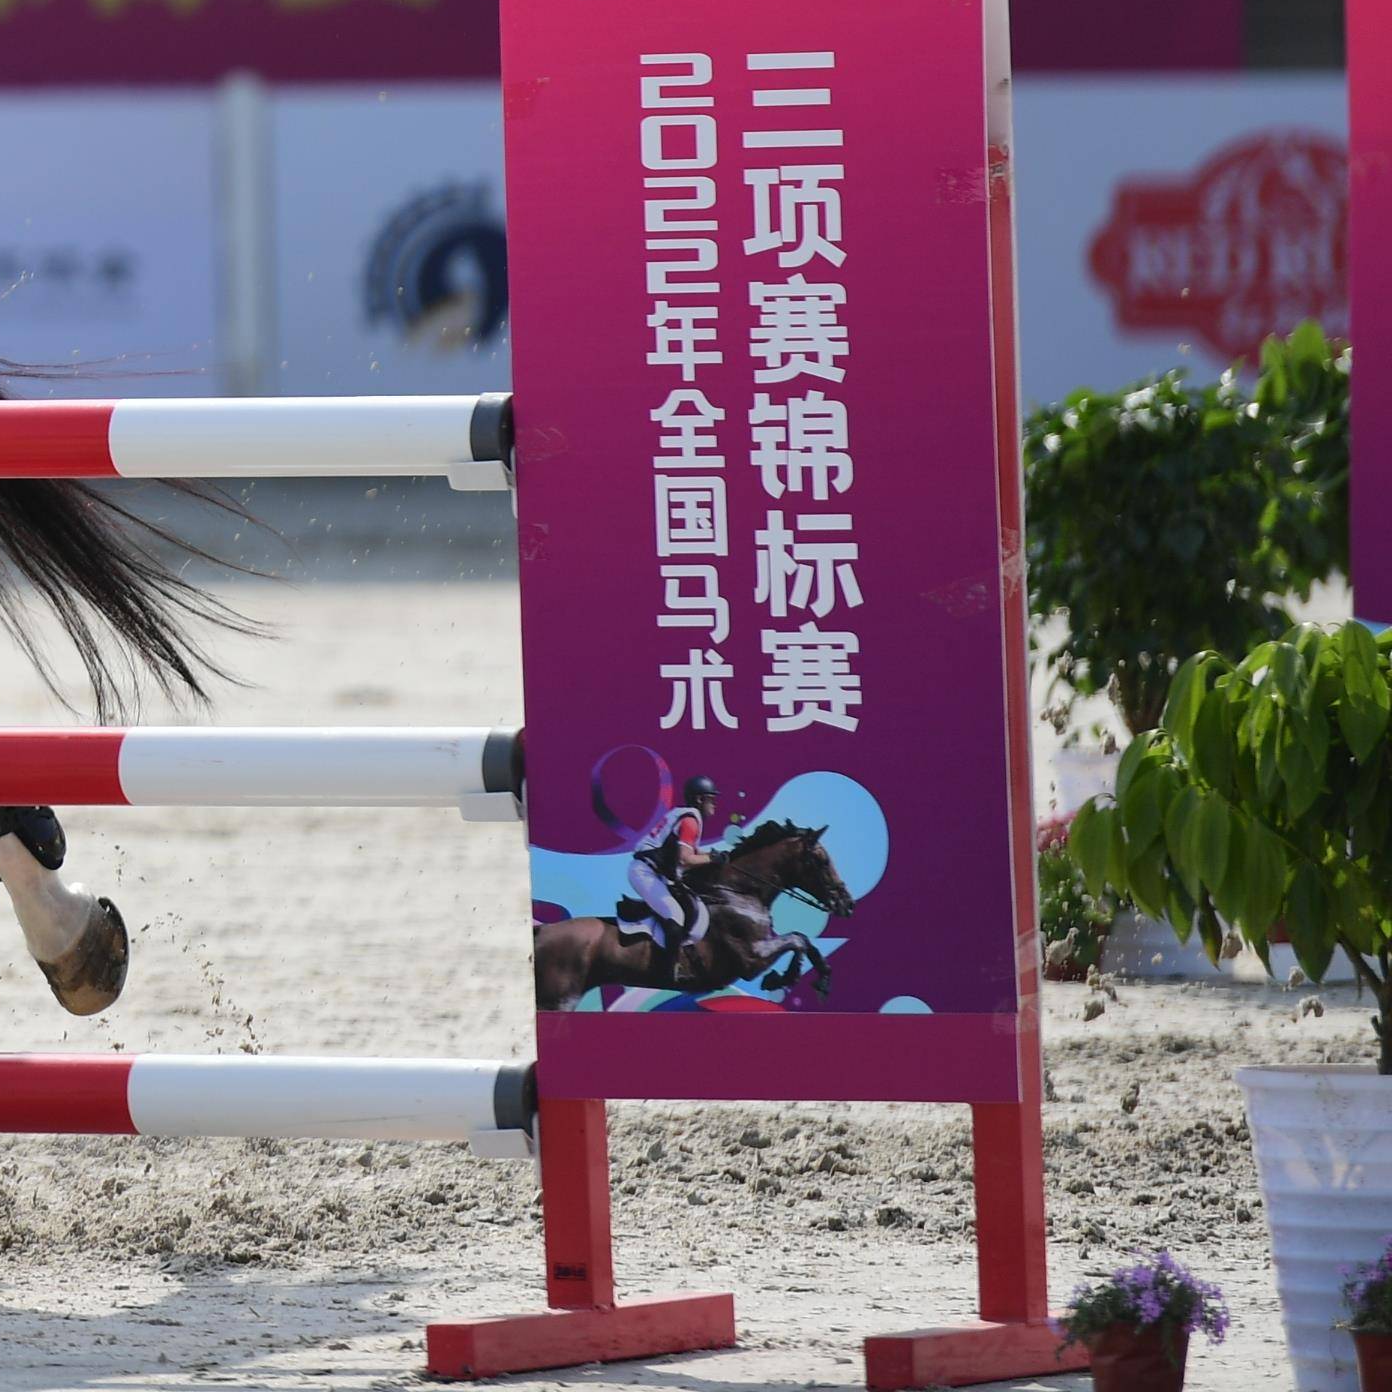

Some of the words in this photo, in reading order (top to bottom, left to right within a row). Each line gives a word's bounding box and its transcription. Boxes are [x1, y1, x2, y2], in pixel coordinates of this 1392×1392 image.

[639, 52, 739, 730] 2022年全国马术
[741, 51, 864, 733] 三项赛锦标赛
